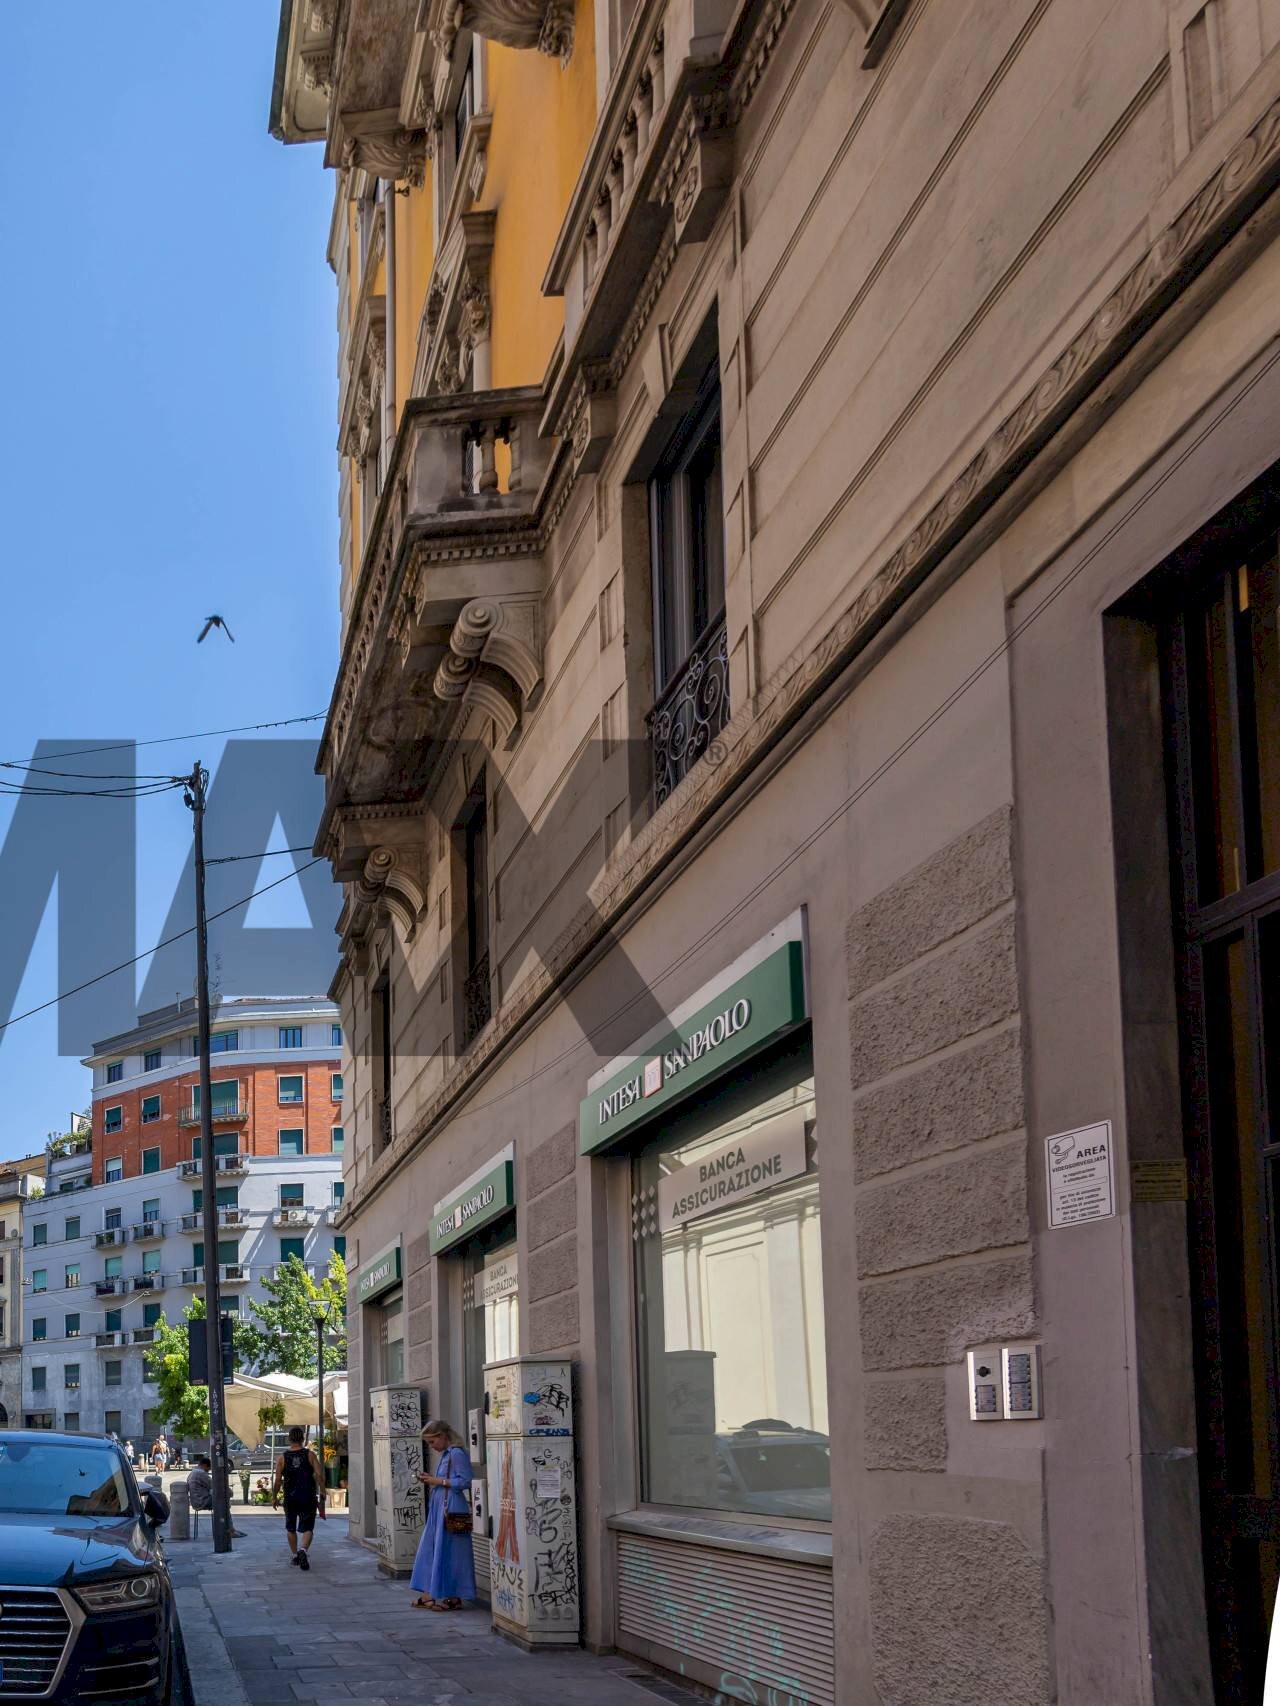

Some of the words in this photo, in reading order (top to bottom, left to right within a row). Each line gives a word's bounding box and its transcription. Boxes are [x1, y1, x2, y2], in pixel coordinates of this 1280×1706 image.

[600, 1075, 642, 1124] INTESA
[664, 998, 750, 1080] SANPAOLO
[699, 1147, 746, 1183] BANCA
[1076, 1144, 1106, 1159] AREA
[672, 1154, 782, 1219] ASSICURAZIONE
[436, 1215, 455, 1239] INTESA
[462, 1184, 494, 1221] SANPAOLO
[489, 1264, 508, 1282] BANCA
